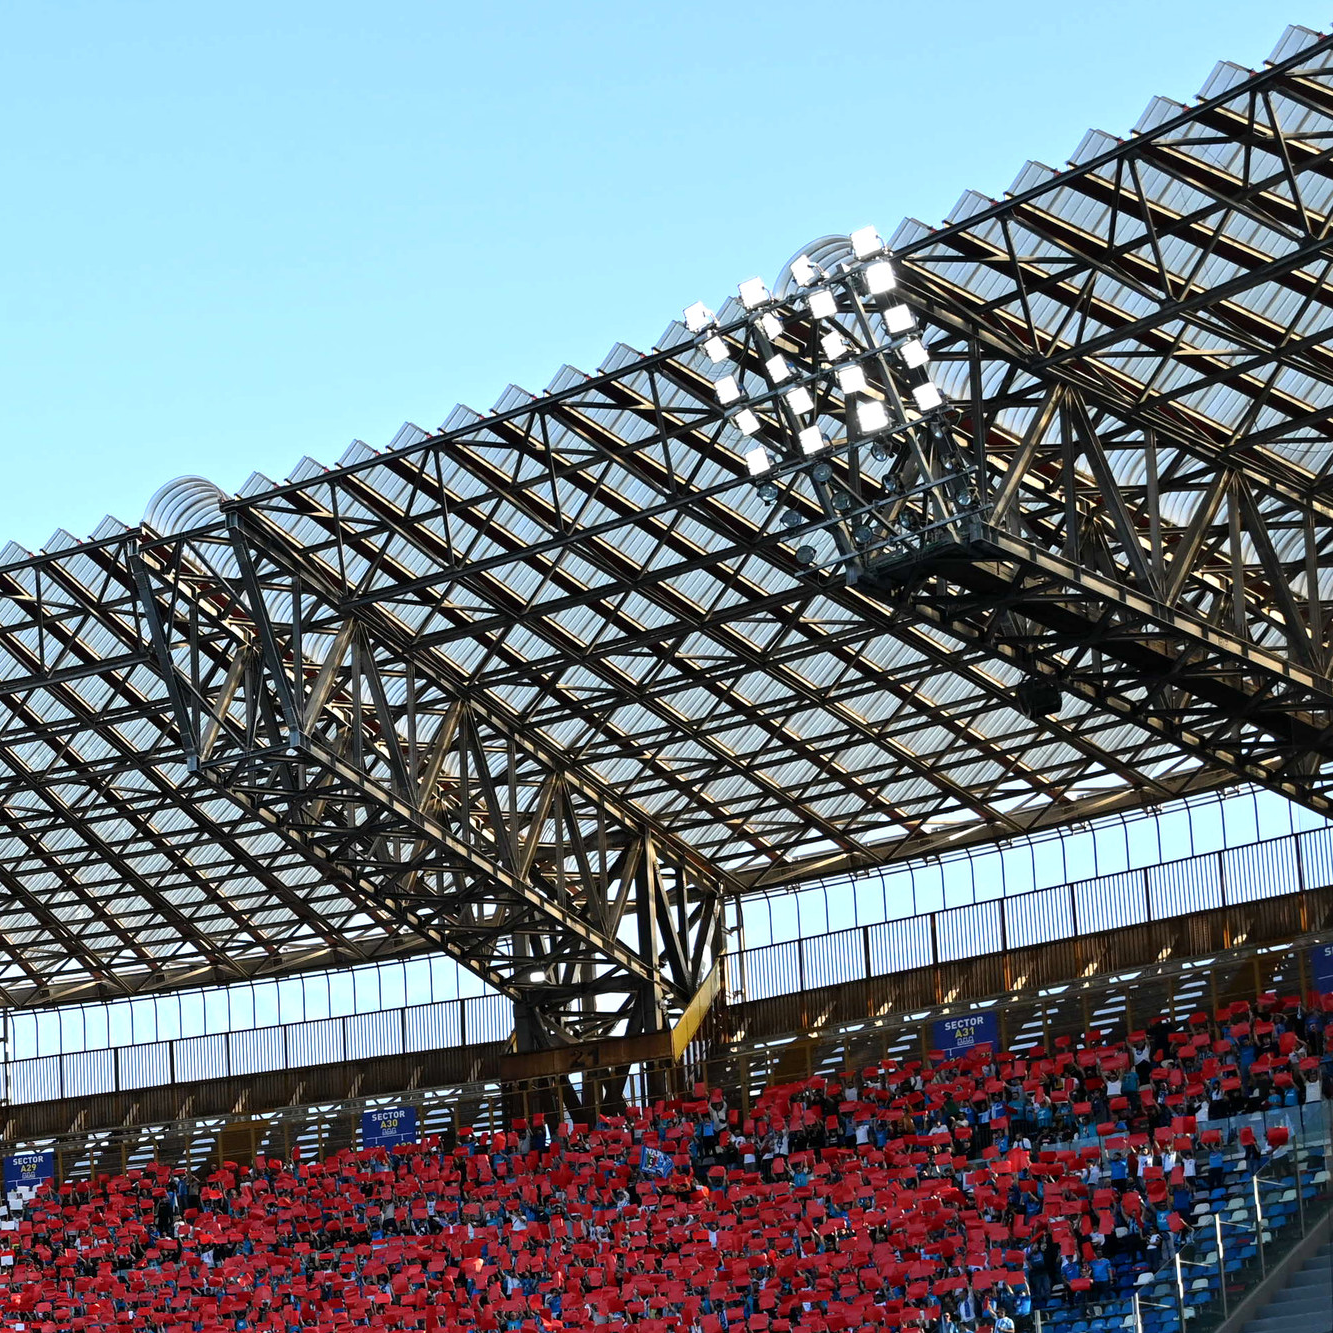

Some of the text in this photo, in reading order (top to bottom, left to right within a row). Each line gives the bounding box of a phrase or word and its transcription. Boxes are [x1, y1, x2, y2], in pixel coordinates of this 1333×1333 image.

[944, 1016, 984, 1031] SECTOR
[954, 1026, 975, 1038] A31
[371, 1110, 405, 1121] SECTOR
[380, 1119, 398, 1129] A30
[12, 1155, 44, 1166] SECTOR
[20, 1164, 37, 1173] A29
